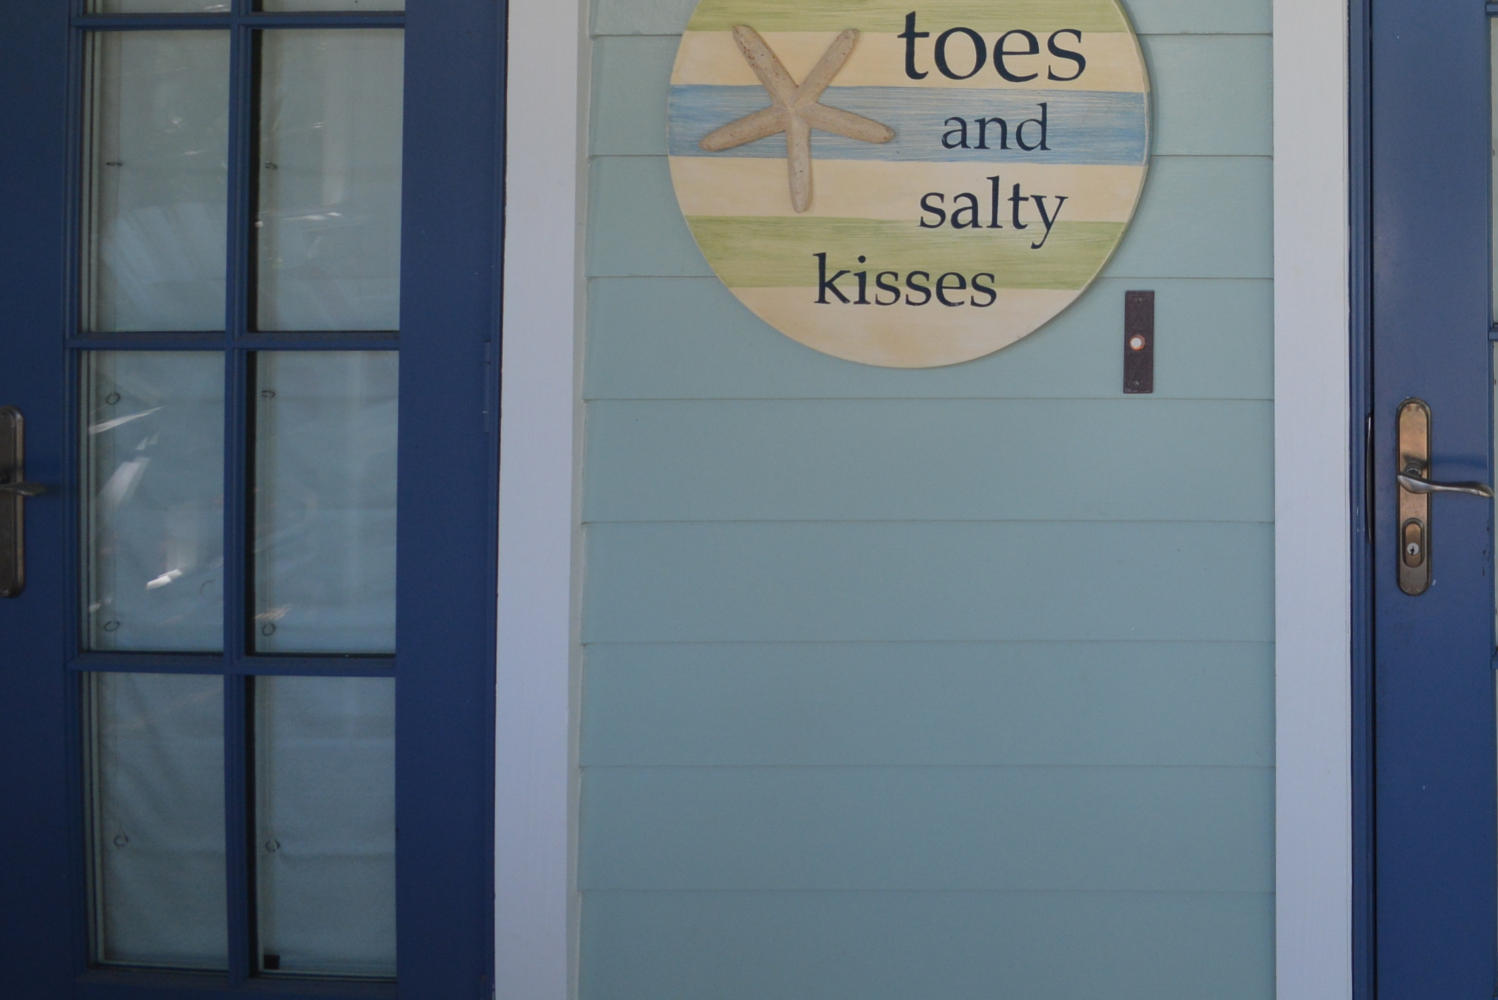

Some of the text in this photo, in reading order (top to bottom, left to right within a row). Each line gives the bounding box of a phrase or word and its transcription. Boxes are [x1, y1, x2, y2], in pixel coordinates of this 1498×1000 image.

[897, 11, 1086, 83] toes
[941, 102, 1051, 152] and
[919, 175, 1068, 250] salty
[813, 252, 997, 308] kisses
